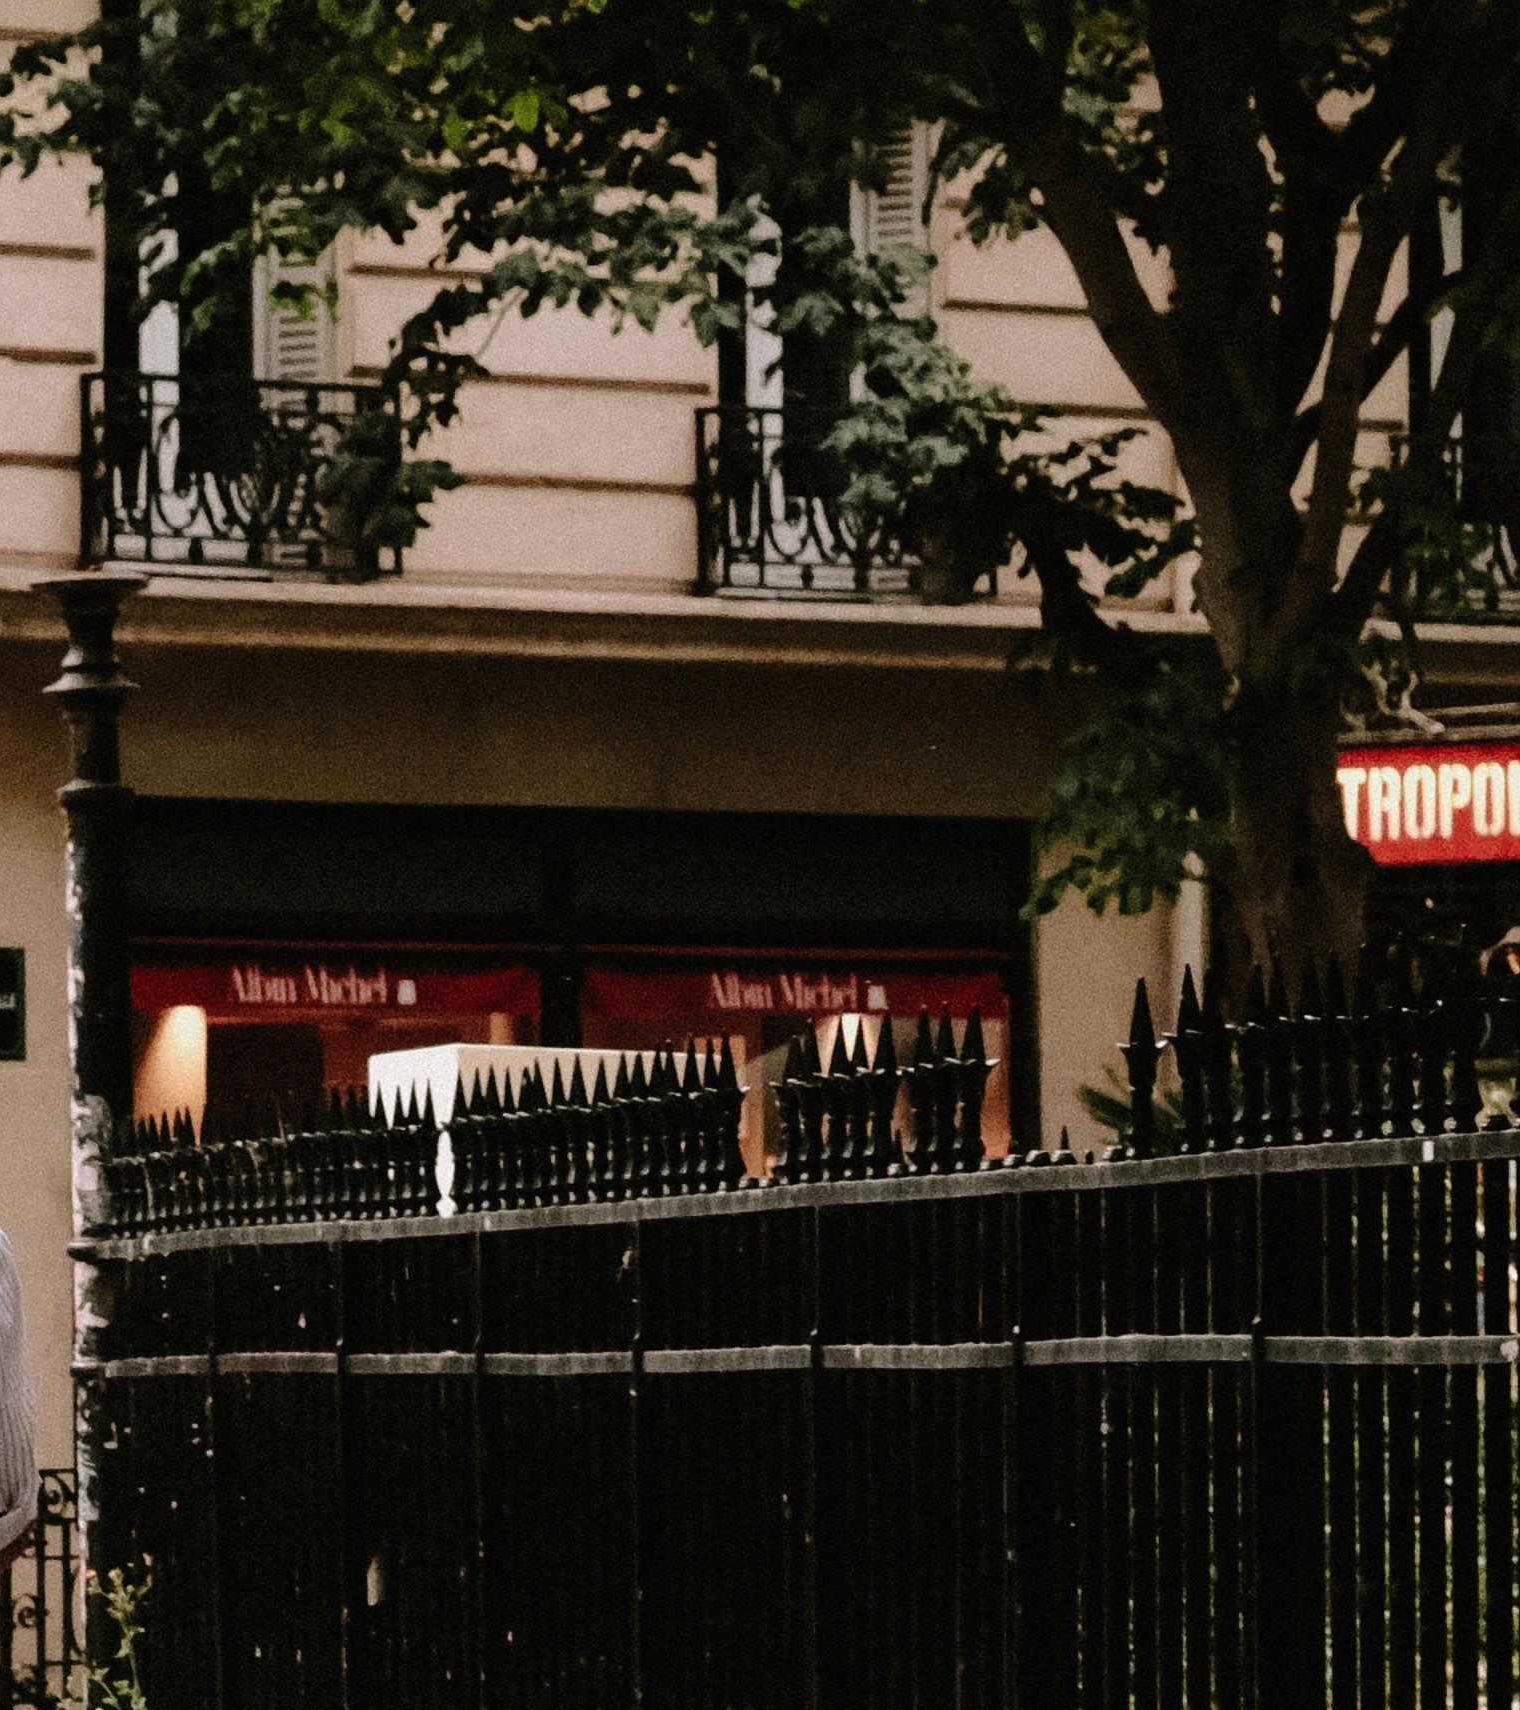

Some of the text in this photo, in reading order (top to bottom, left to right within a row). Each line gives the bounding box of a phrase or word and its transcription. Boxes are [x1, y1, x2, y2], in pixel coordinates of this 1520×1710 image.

[231, 964, 388, 1004] Albin Michel
[711, 972, 858, 1010] Albin Michel
